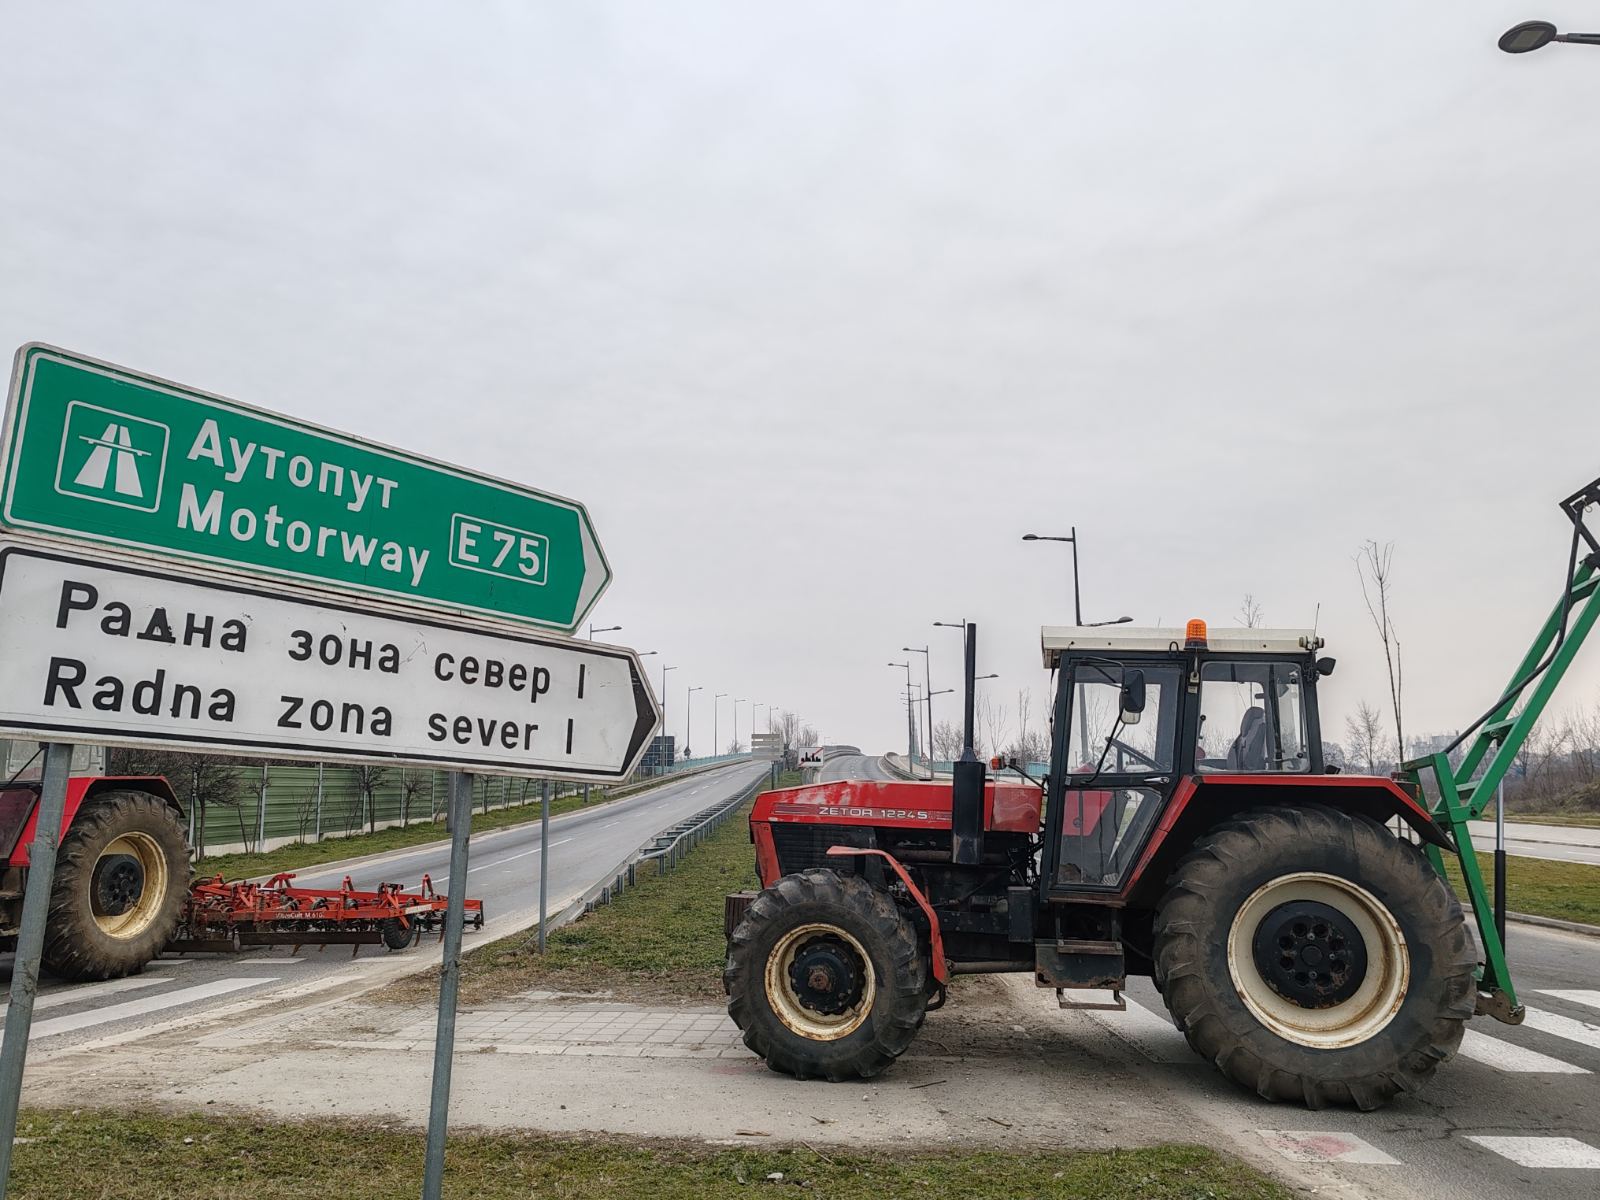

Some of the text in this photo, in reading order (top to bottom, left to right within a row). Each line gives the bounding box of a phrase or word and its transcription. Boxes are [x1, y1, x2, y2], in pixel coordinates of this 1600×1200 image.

[187, 418, 399, 513] Аутопут
[177, 482, 430, 587] Motorway
[457, 521, 541, 577] E 75
[55, 579, 247, 653] Радна
[288, 629, 400, 674] зона
[434, 652, 551, 704] север
[43, 656, 236, 723] Radna
[277, 695, 393, 737] zona
[427, 712, 539, 752] sever
[818, 806, 928, 820] ZETOR 12245
